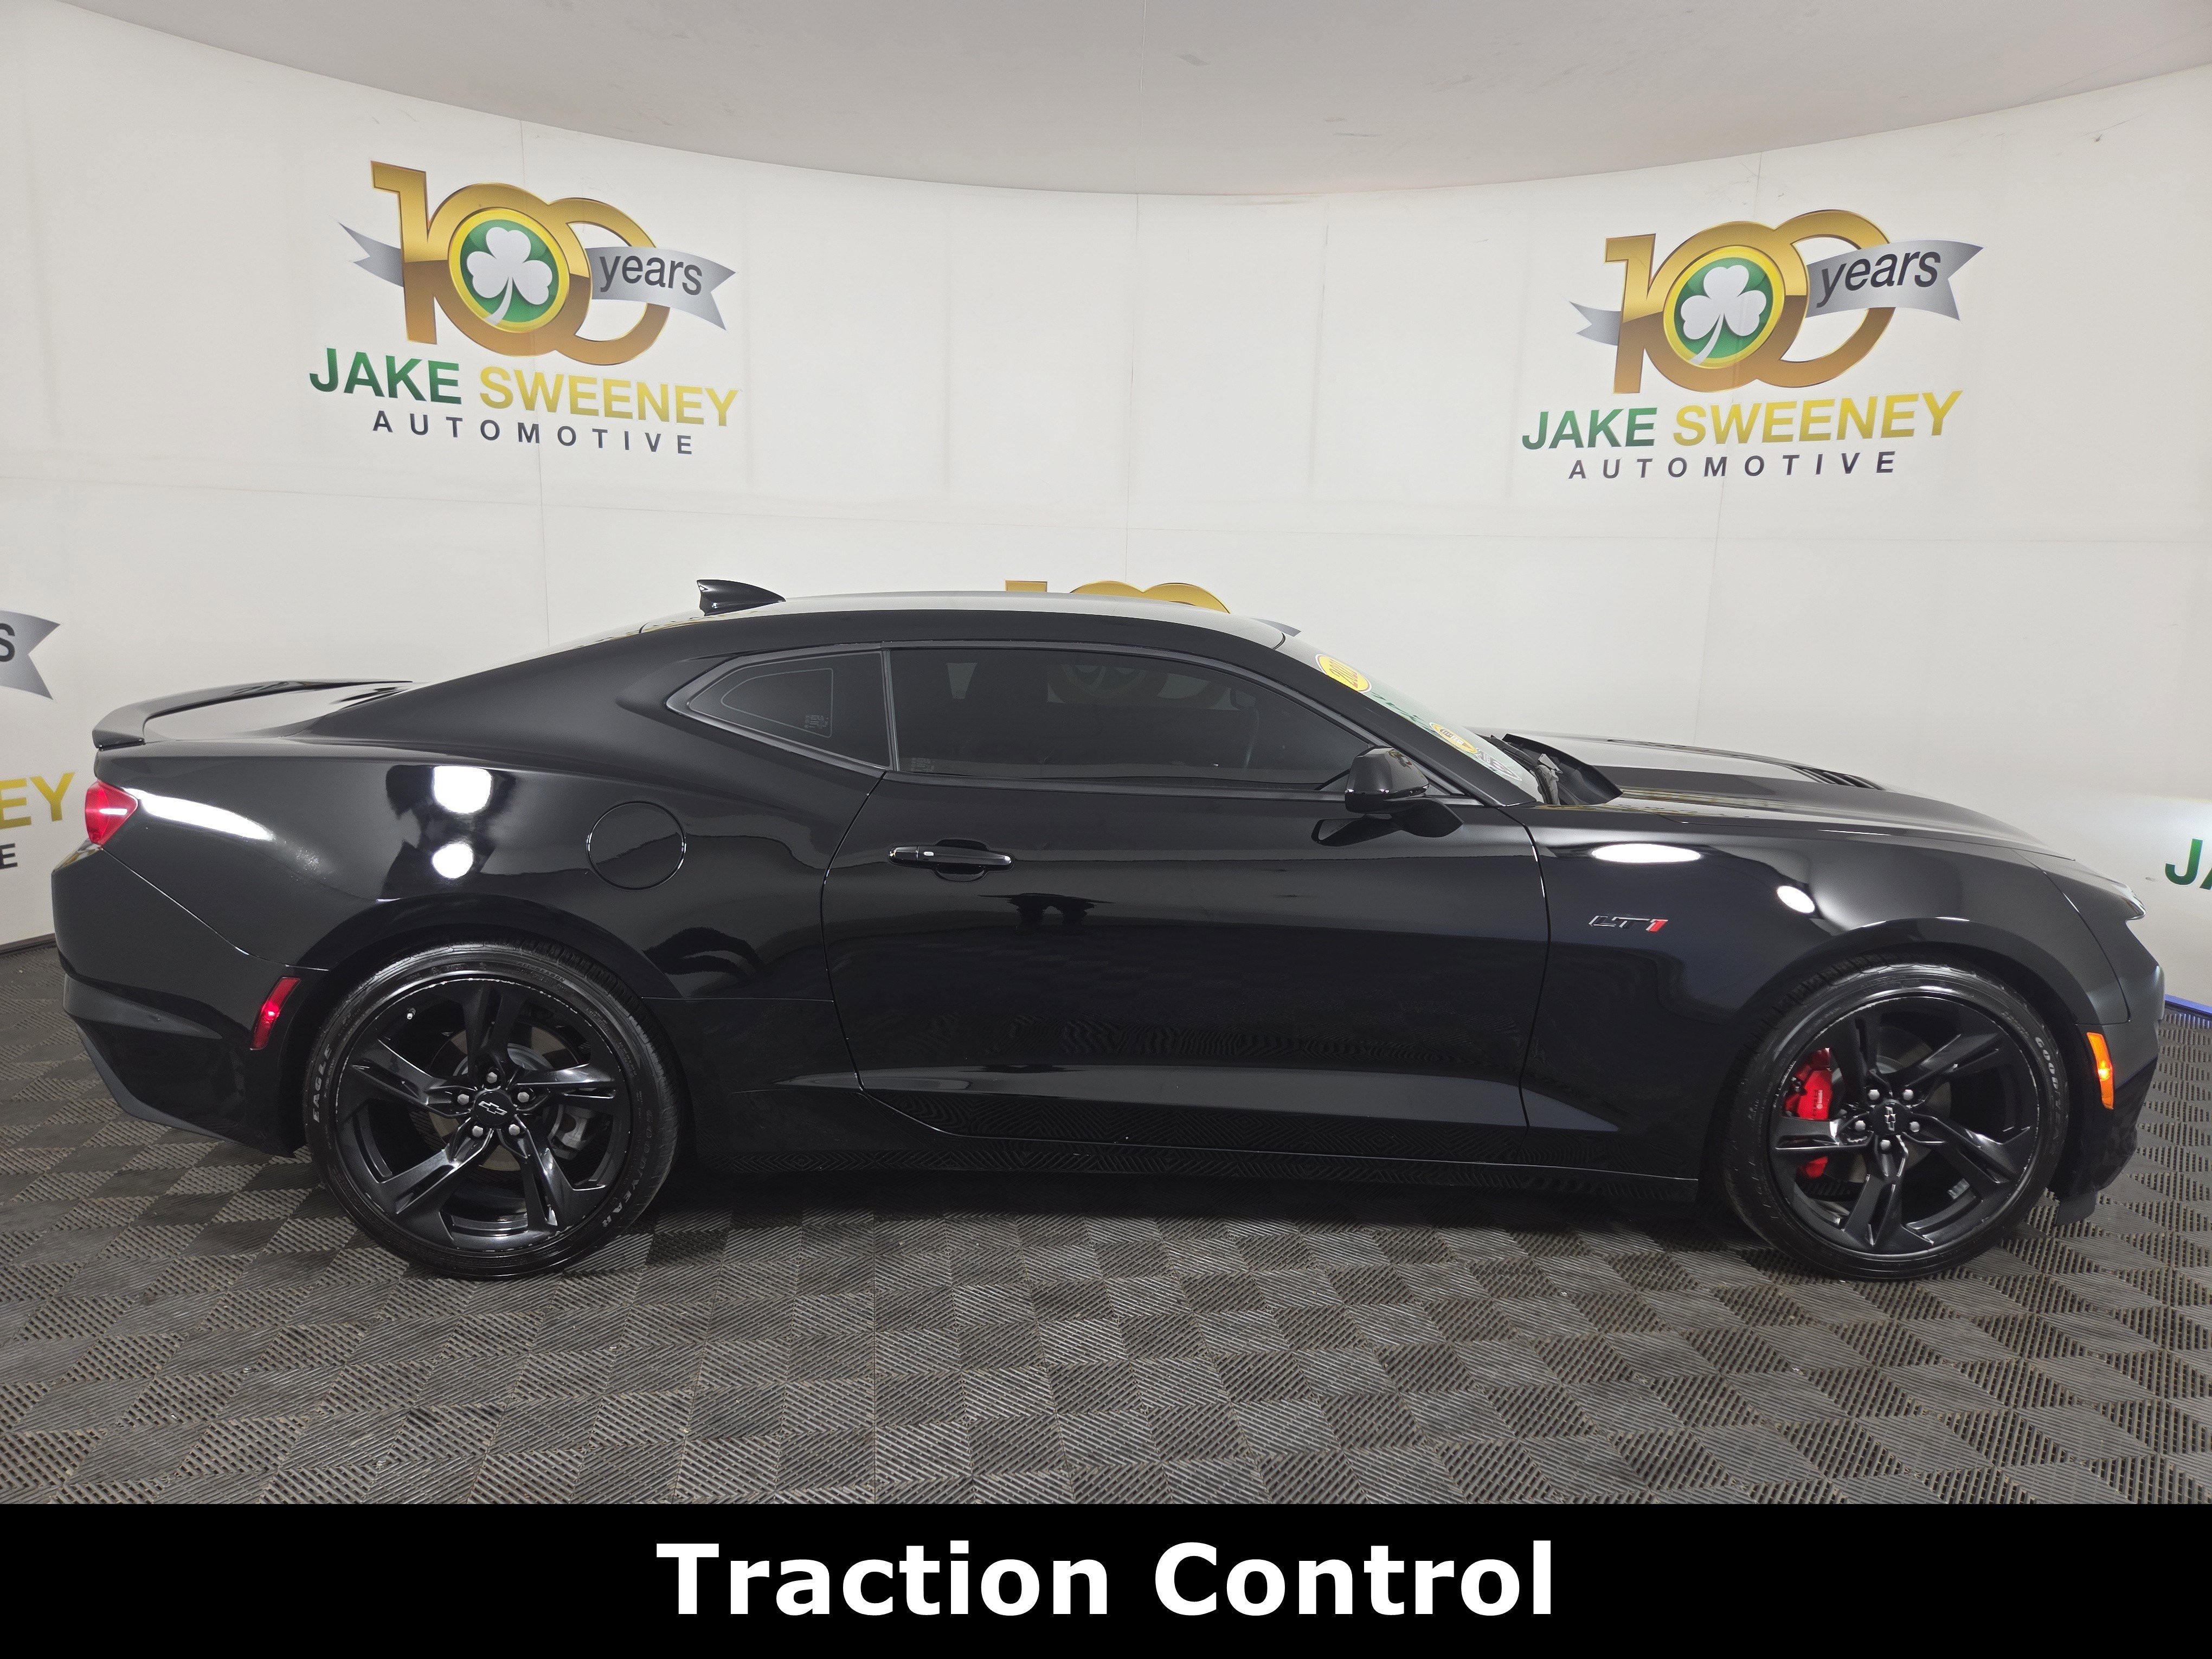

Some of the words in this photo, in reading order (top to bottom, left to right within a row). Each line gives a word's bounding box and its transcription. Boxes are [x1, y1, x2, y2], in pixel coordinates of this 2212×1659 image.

[599, 252, 703, 296] years
[1816, 249, 1941, 308] years
[309, 348, 462, 404] JAKE
[479, 366, 740, 427] SWEENEY
[372, 410, 693, 455] AUTOMOTIVE
[1522, 407, 1658, 450] JAKE
[1673, 390, 1963, 447] SWEENEY
[1568, 451, 1896, 480] AUTOMOTIVE
[1589, 915, 1669, 932] LT1
[313, 1044, 332, 1123] EAGLE
